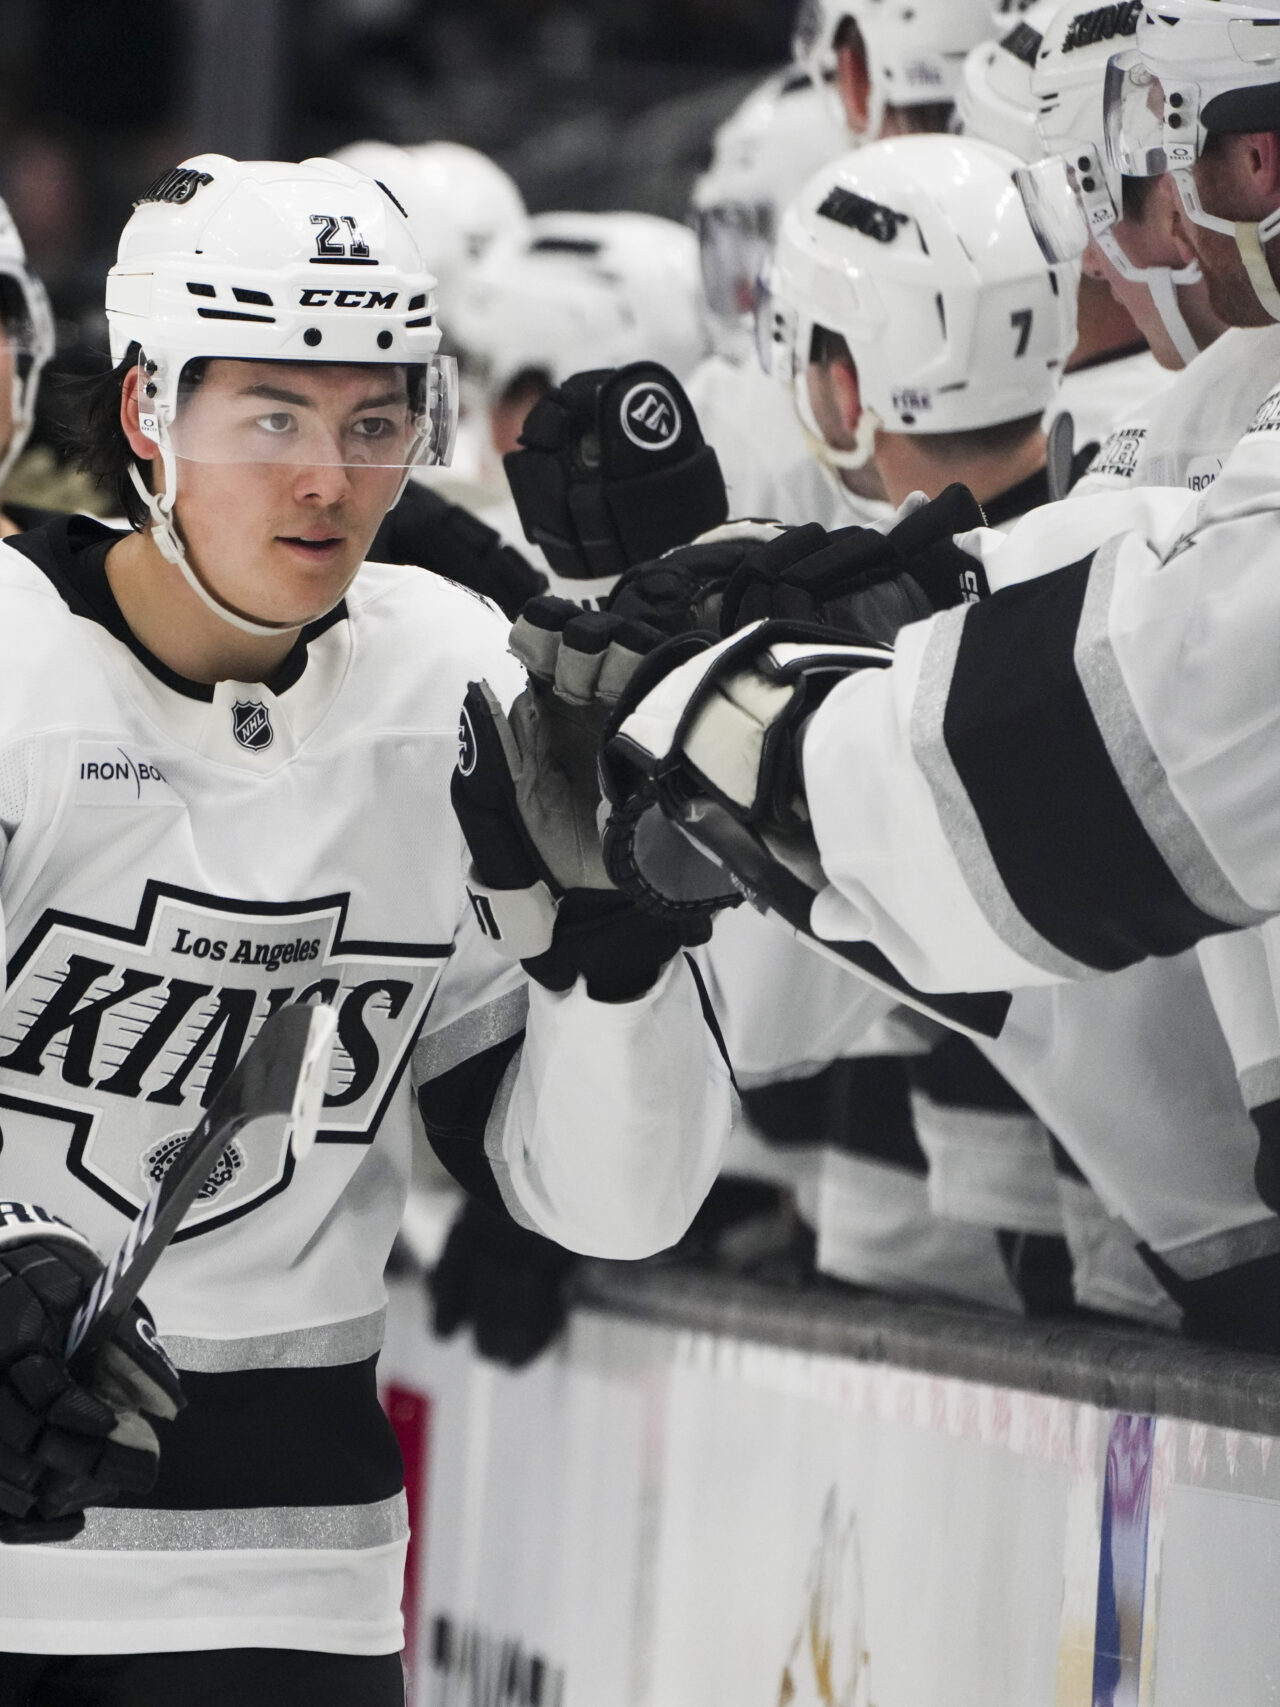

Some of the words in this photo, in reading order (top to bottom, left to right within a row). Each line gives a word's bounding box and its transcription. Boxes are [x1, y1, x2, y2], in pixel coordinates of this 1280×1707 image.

[309, 214, 370, 258] 21
[298, 289, 400, 310] CCM
[1010, 309, 1033, 358] 7
[241, 712, 265, 742] NHL
[80, 762, 129, 780] IRON
[137, 763, 162, 781] BO
[171, 928, 227, 961] Los
[229, 937, 322, 972] Angeles
